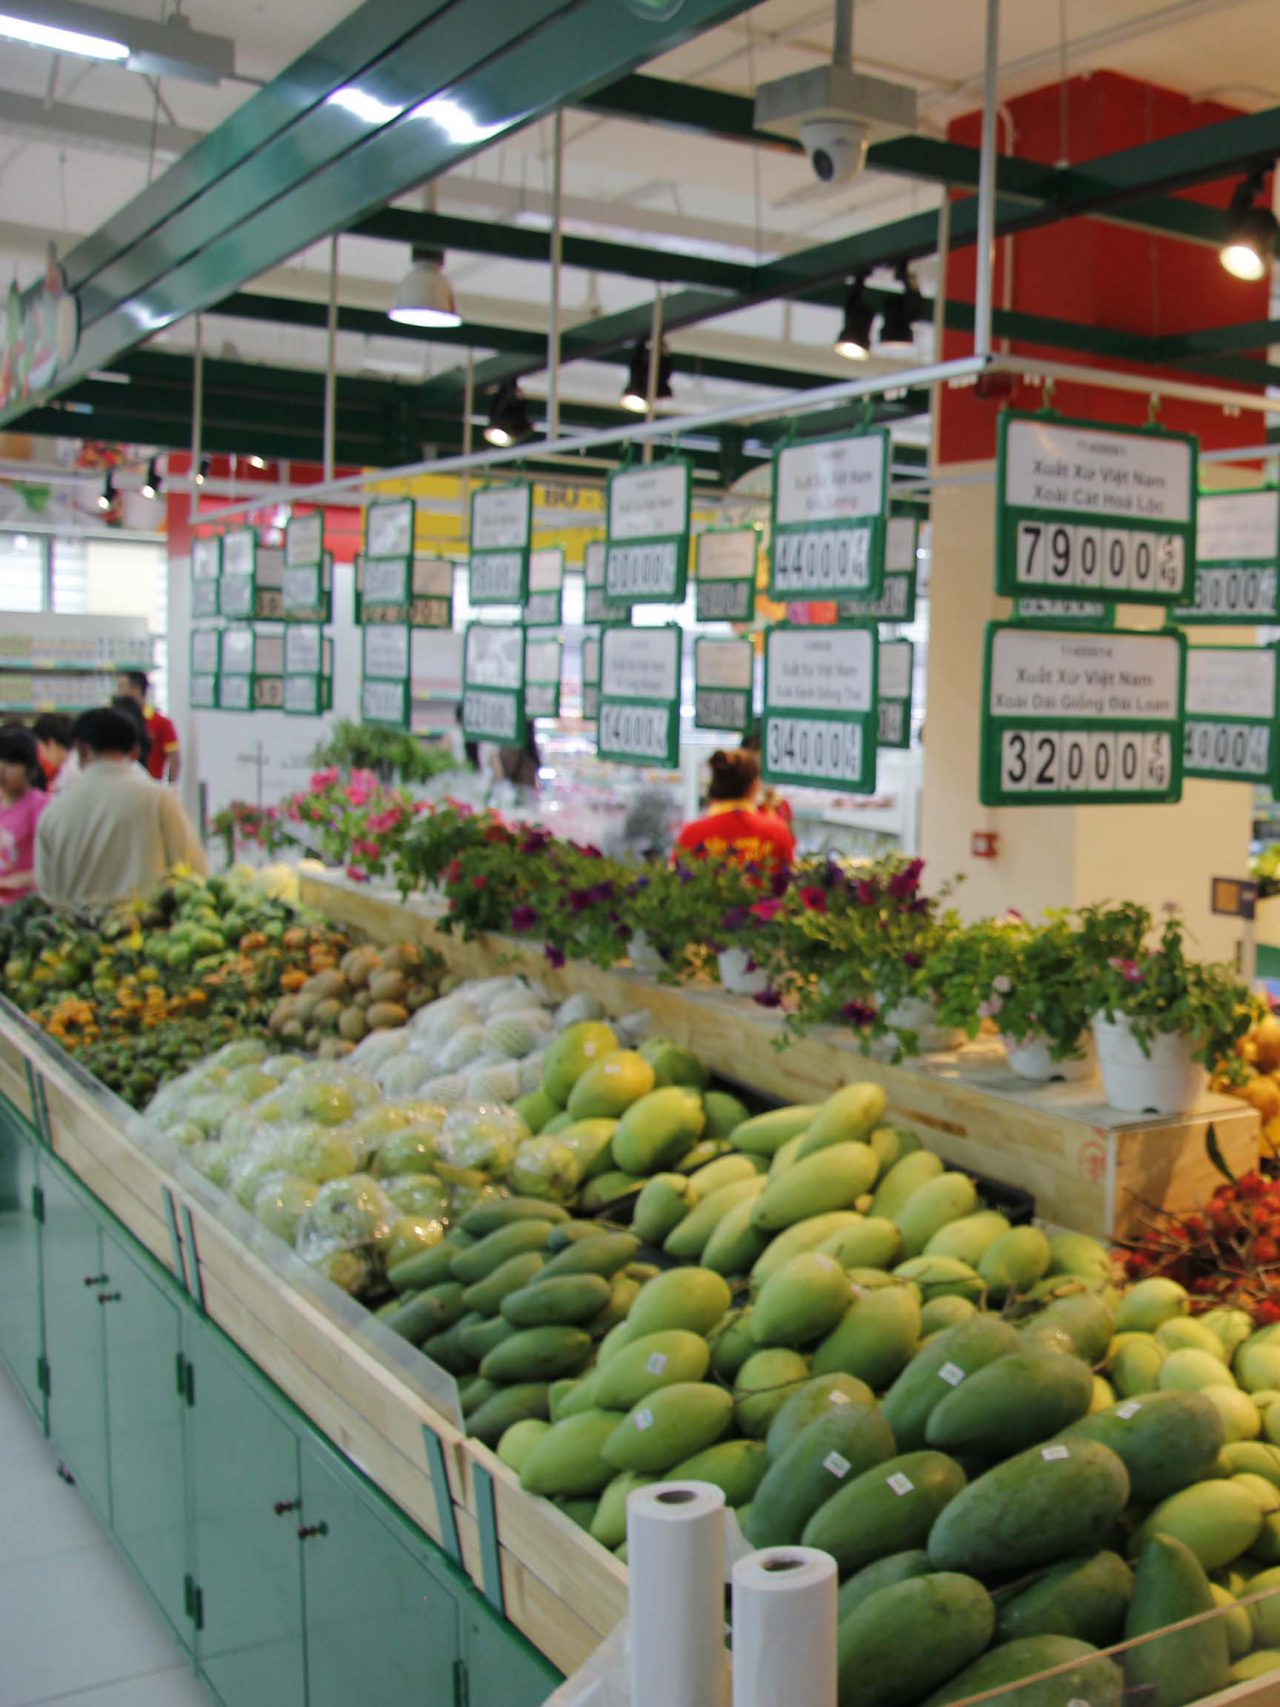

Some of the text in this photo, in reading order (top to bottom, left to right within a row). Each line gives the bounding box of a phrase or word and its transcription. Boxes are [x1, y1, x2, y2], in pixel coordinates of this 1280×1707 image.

[1100, 466, 1129, 487] Việt
[1134, 471, 1165, 488] Nam
[1084, 669, 1115, 689] Việt
[1119, 671, 1153, 687] Nam
